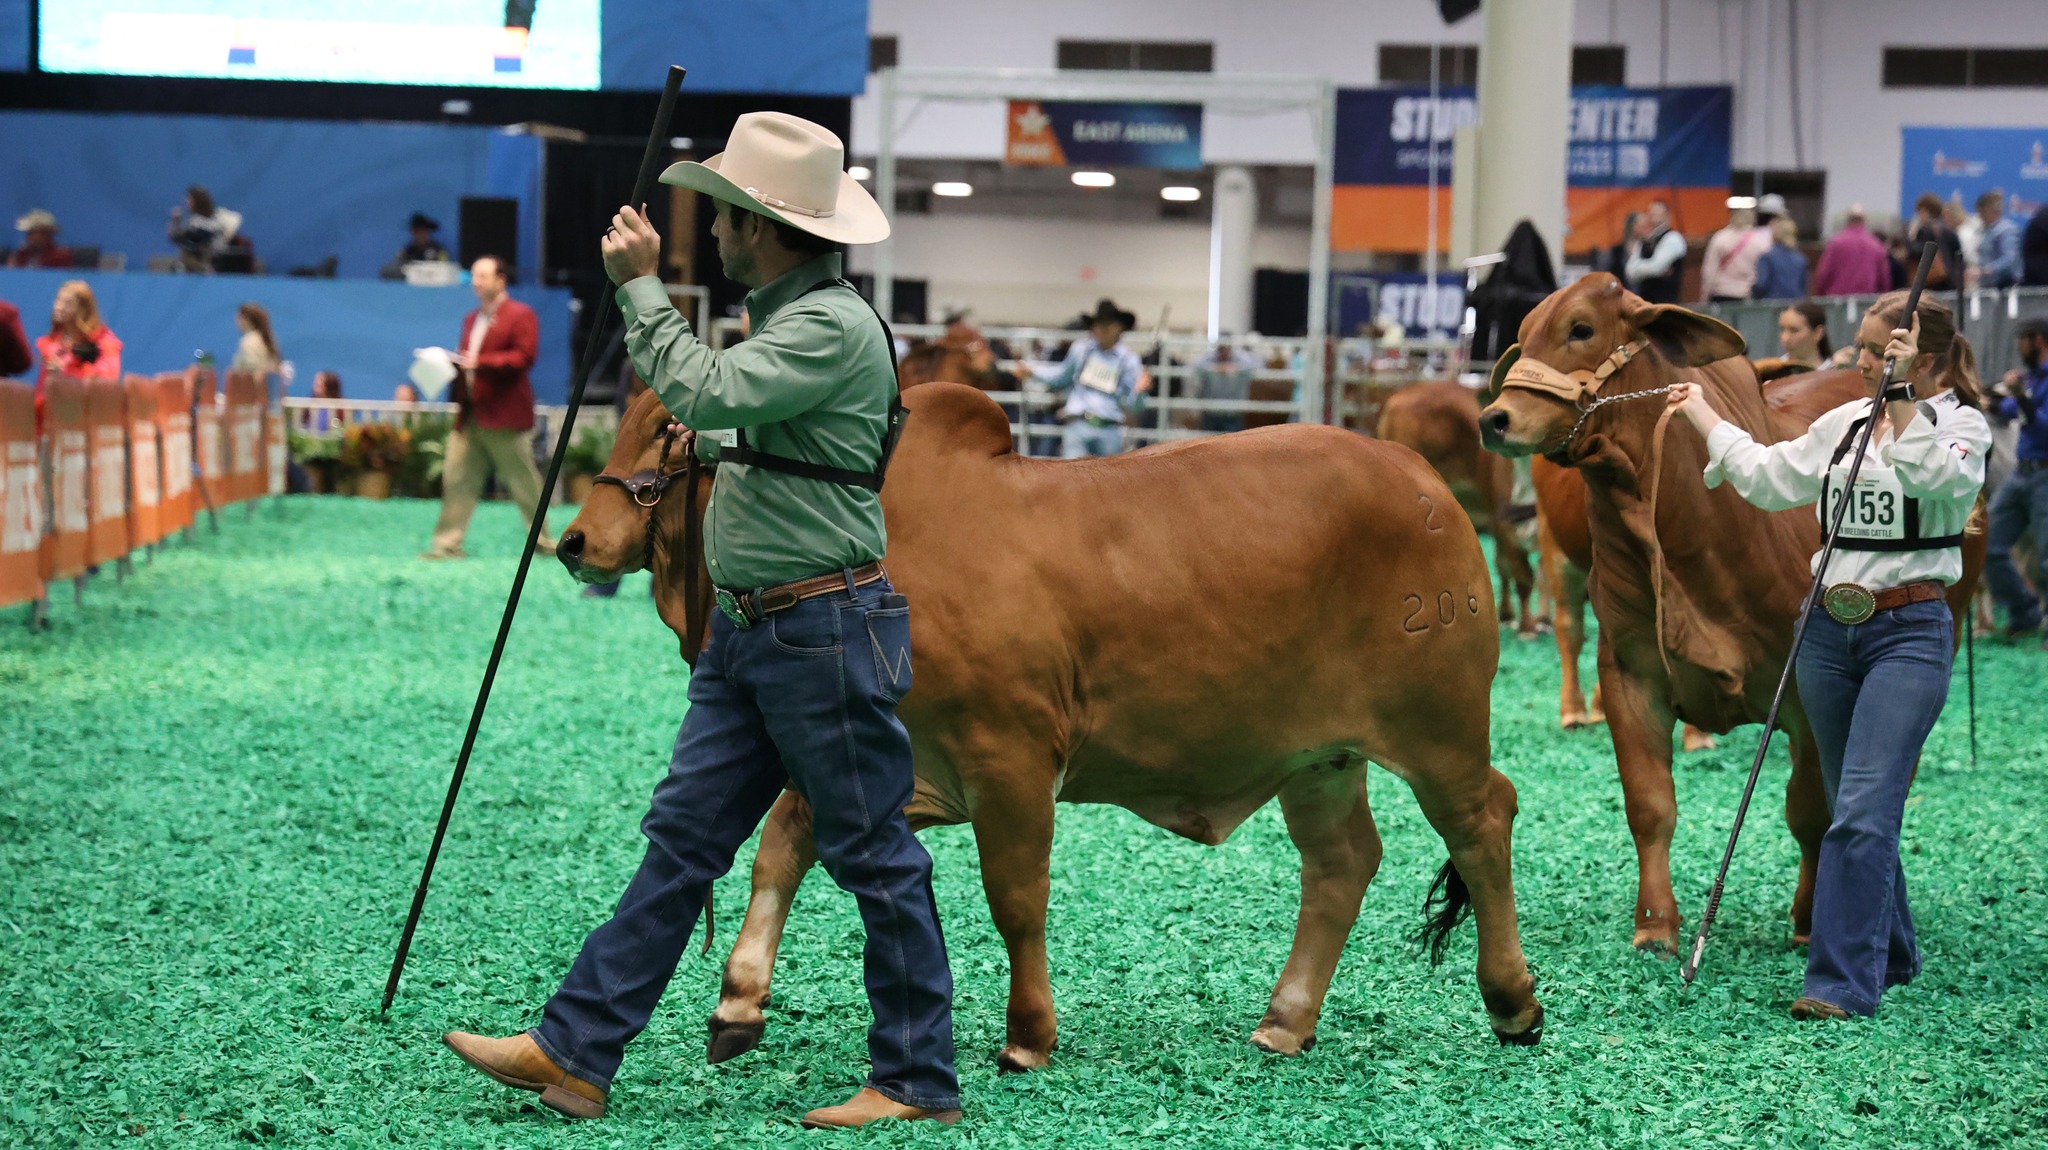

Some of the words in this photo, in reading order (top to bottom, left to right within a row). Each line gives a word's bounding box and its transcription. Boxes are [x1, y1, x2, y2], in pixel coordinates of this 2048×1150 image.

[1072, 119, 1122, 143] EAST
[1418, 494, 1444, 532] 2
[1832, 487, 1895, 525] 2153
[1844, 527, 1870, 537] BREEDING
[1870, 529, 1893, 537] CATTLE
